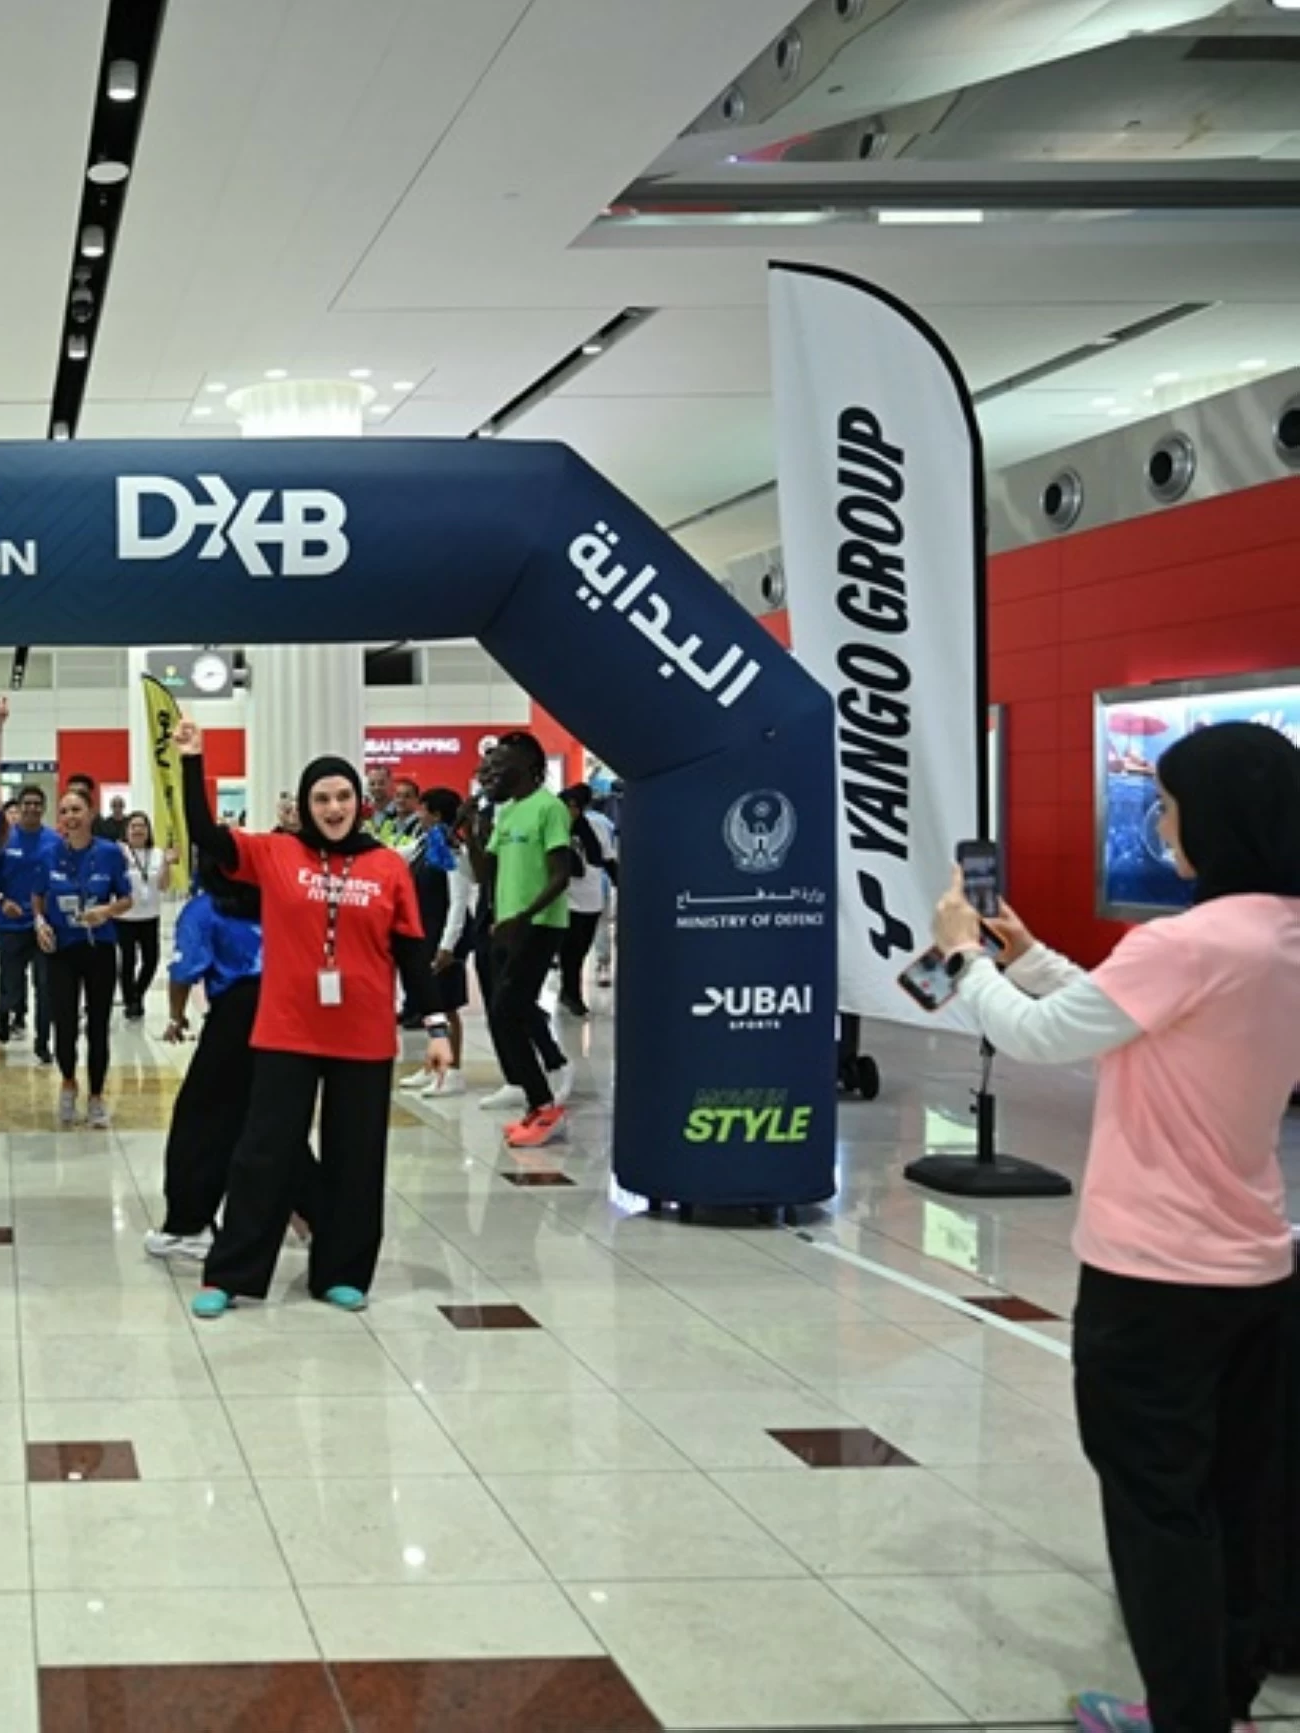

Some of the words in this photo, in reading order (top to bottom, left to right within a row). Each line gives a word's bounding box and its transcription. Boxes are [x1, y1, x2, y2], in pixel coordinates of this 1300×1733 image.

[568, 519, 762, 708] البداية
[836, 405, 908, 636] GROUP
[836, 642, 912, 862] YANGO
[676, 914, 747, 928] MINISTRY
[683, 1105, 812, 1143] STYLE
